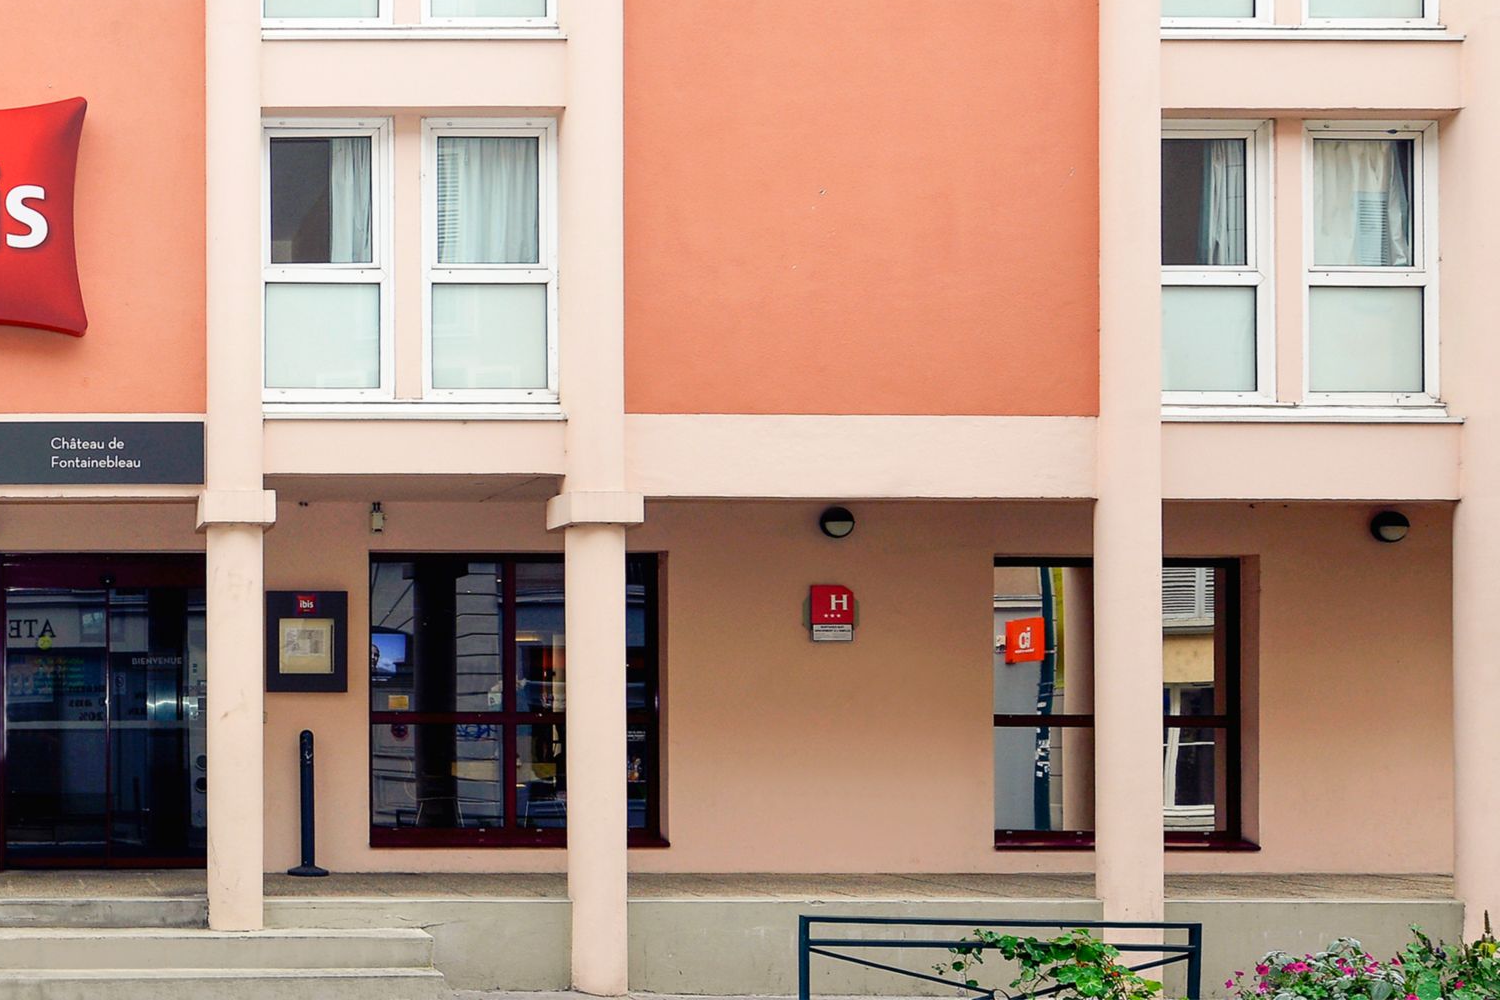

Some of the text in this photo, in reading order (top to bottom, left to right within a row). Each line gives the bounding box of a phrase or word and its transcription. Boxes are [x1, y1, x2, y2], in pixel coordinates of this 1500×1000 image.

[50, 436, 125, 450] Château de
[51, 455, 141, 468] Fontainebleau
[299, 600, 314, 608] ibis
[830, 594, 848, 610] H
[131, 656, 183, 665] BIENVENUE
